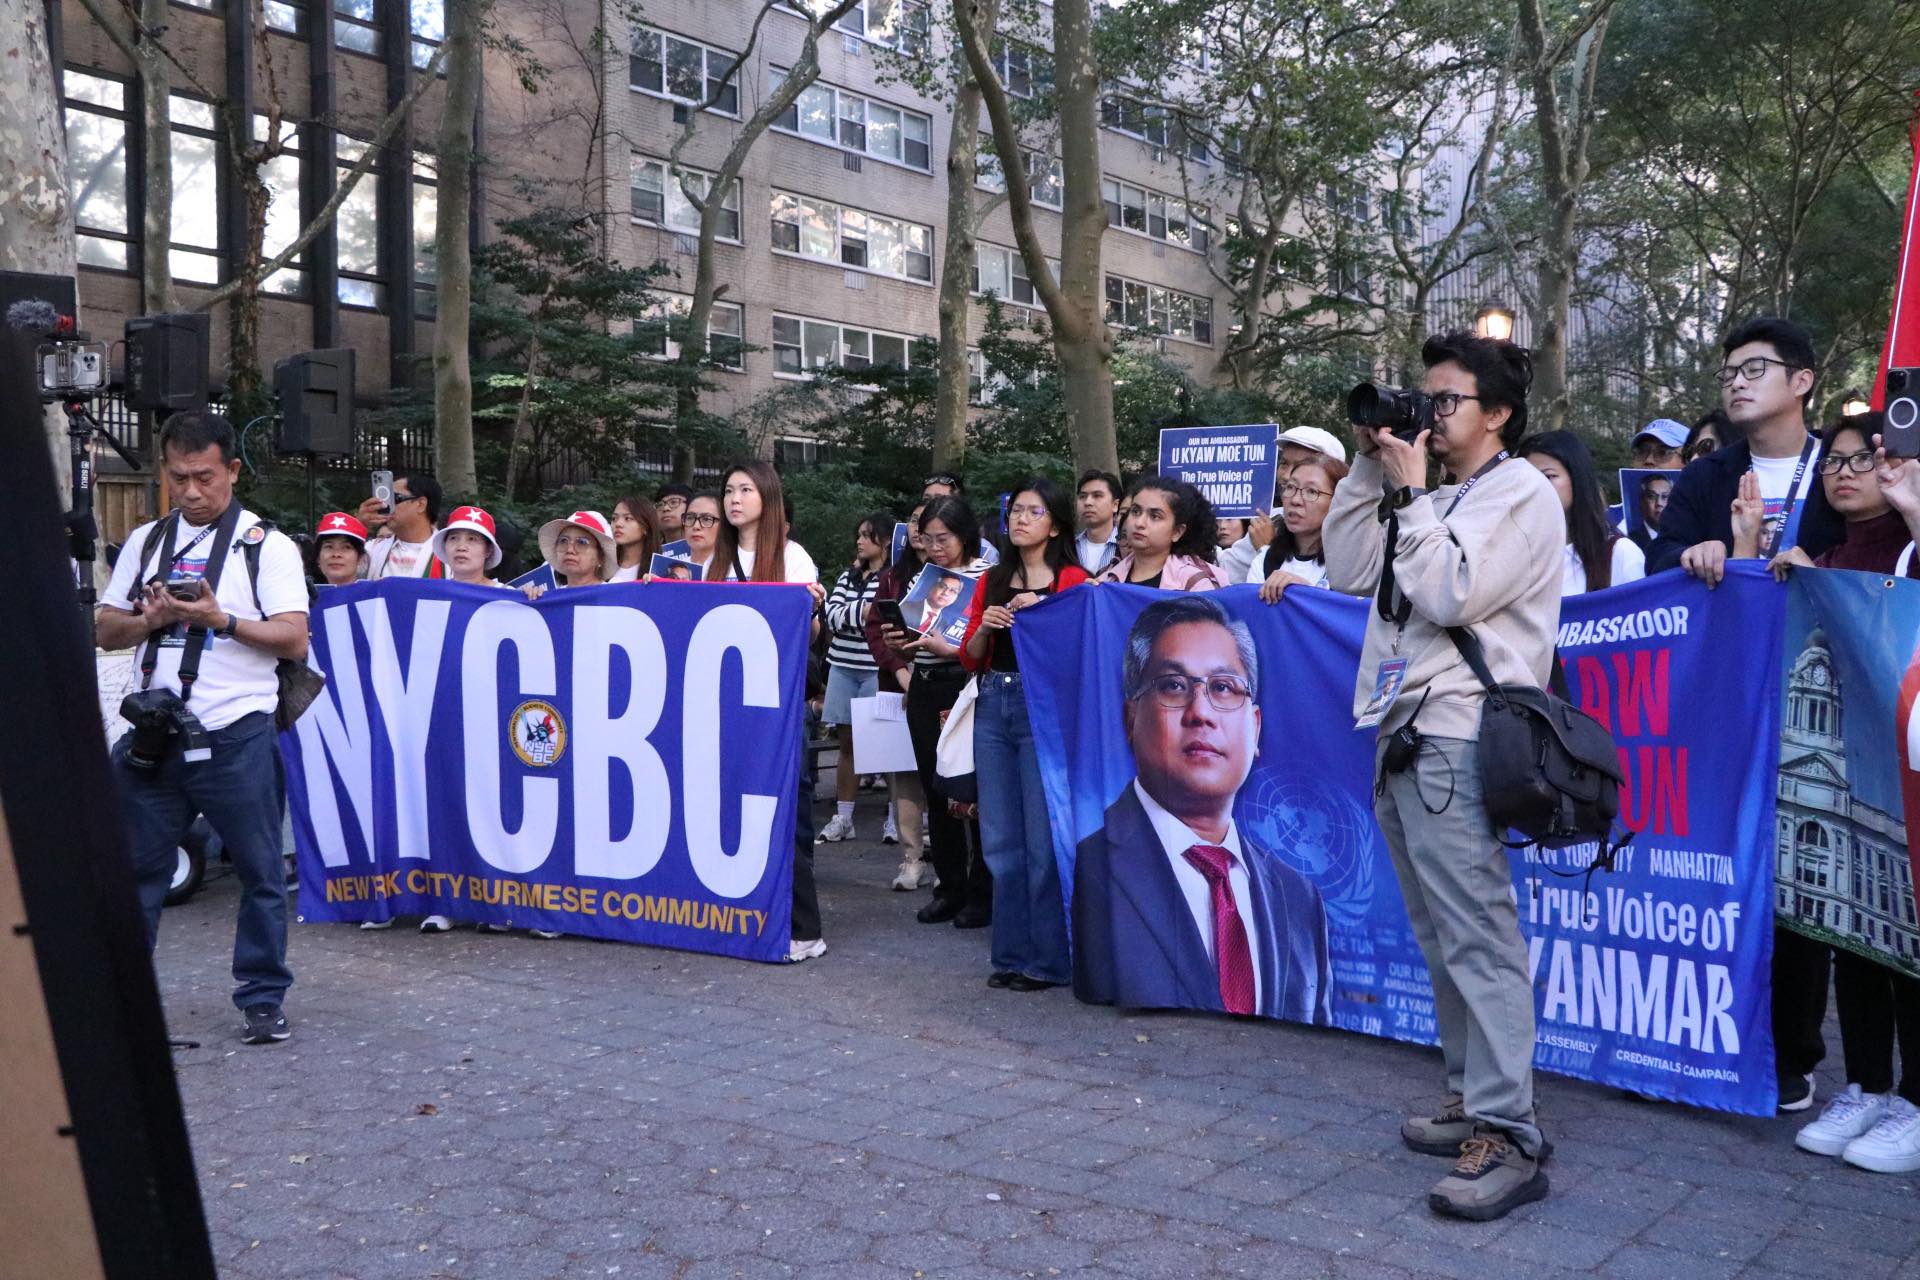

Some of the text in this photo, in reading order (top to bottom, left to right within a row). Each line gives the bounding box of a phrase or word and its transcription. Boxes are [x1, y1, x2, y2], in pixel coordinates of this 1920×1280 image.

[1172, 444, 1266, 464] U KYAW MOE TUN
[1181, 471, 1196, 483] The
[1196, 470, 1217, 483] True
[1242, 470, 1254, 481] of
[1793, 462, 1807, 483] STAFF
[1198, 483, 1253, 505] ANMAR
[1776, 511, 1790, 532] STAFF
[194, 529, 211, 545] STAFF
[1555, 606, 1689, 648] MBASSADOR
[295, 597, 781, 899] NYCBC
[1615, 746, 1689, 838] UN
[1650, 848, 1735, 885] MANHATTAN
[325, 875, 369, 903] NEW
[407, 869, 464, 898] CITY
[469, 875, 597, 915] BURMESE
[602, 890, 768, 937] COMMUNITY
[1525, 877, 1600, 932] True
[1606, 886, 1697, 947] Voice
[1701, 901, 1741, 952] of
[1386, 993, 1397, 1008] U
[1528, 936, 1741, 1055] ANMAR
[1544, 1034, 1598, 1054] ASSEMBLY
[1616, 1049, 1740, 1083] CREDENTIALS CAMPAIGN
